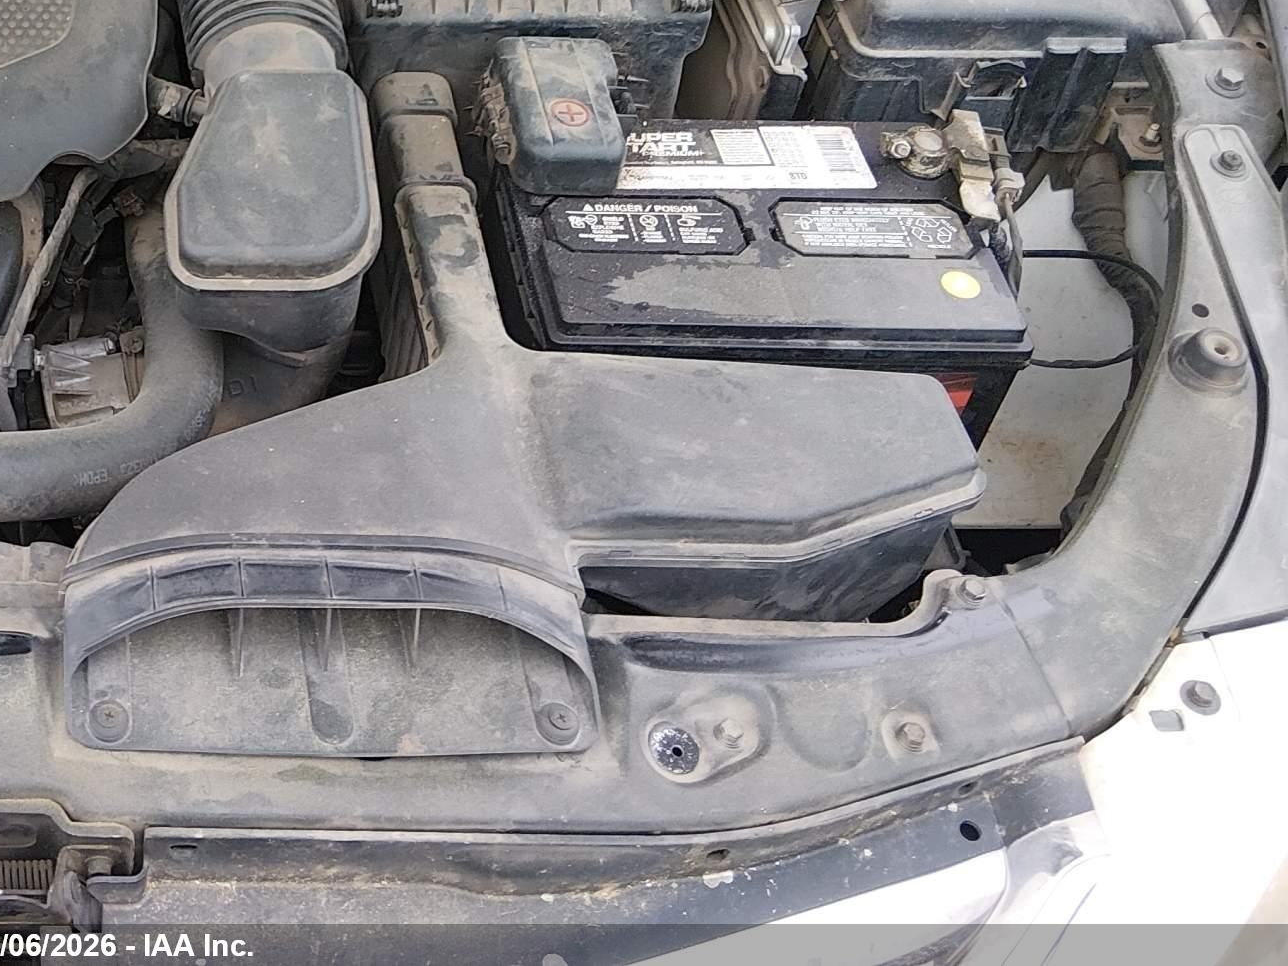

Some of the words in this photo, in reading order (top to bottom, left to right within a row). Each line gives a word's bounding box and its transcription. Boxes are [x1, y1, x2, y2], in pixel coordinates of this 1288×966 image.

[626, 132, 694, 143] UPER
[594, 204, 643, 213] DANGER
[654, 204, 698, 213] POISON
